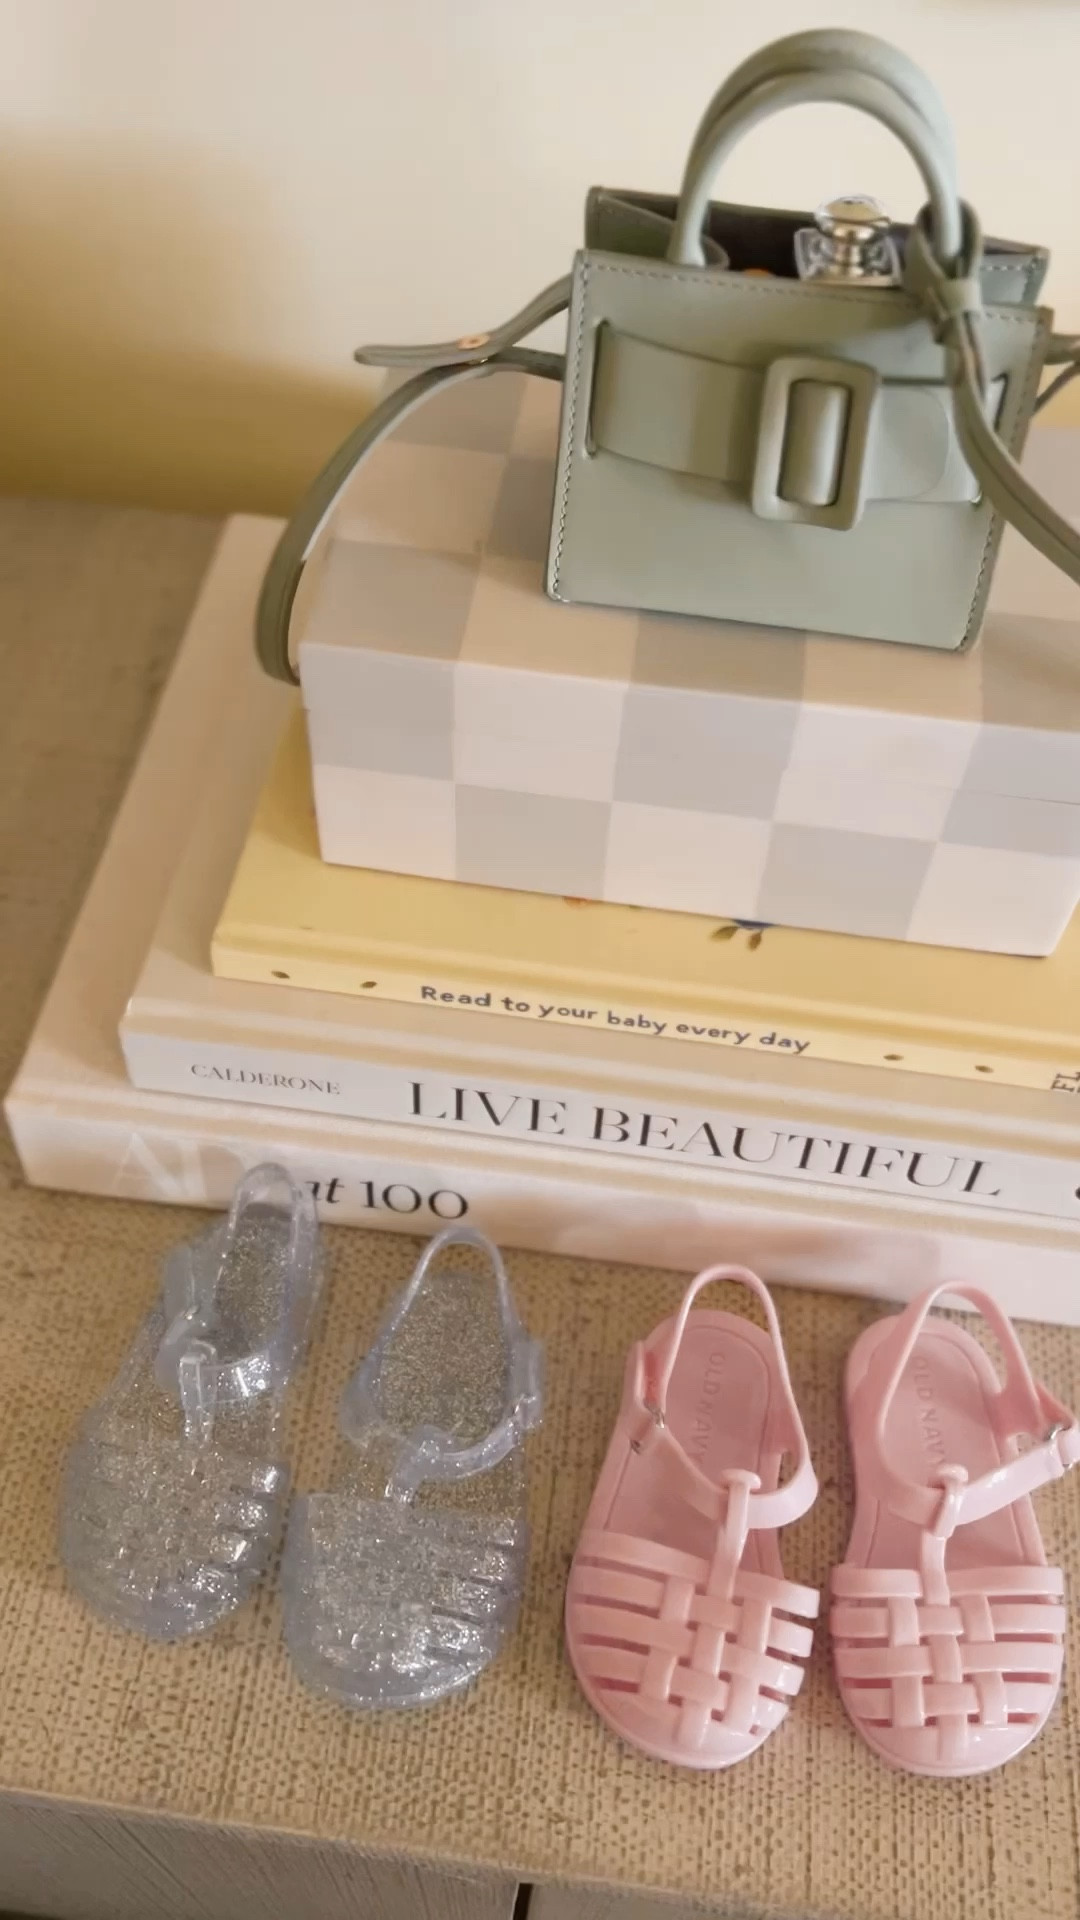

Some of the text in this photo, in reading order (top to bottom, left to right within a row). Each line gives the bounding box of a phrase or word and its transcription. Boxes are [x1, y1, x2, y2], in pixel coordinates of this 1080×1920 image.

[420, 985, 811, 1055] Read to your baby every day
[190, 1063, 341, 1095] CALDERONE
[408, 1081, 1002, 1197] LIVE BEAUTIFUL
[359, 1180, 469, 1220] 100
[703, 1351, 726, 1396] OLD
[909, 1355, 936, 1401] OLD
